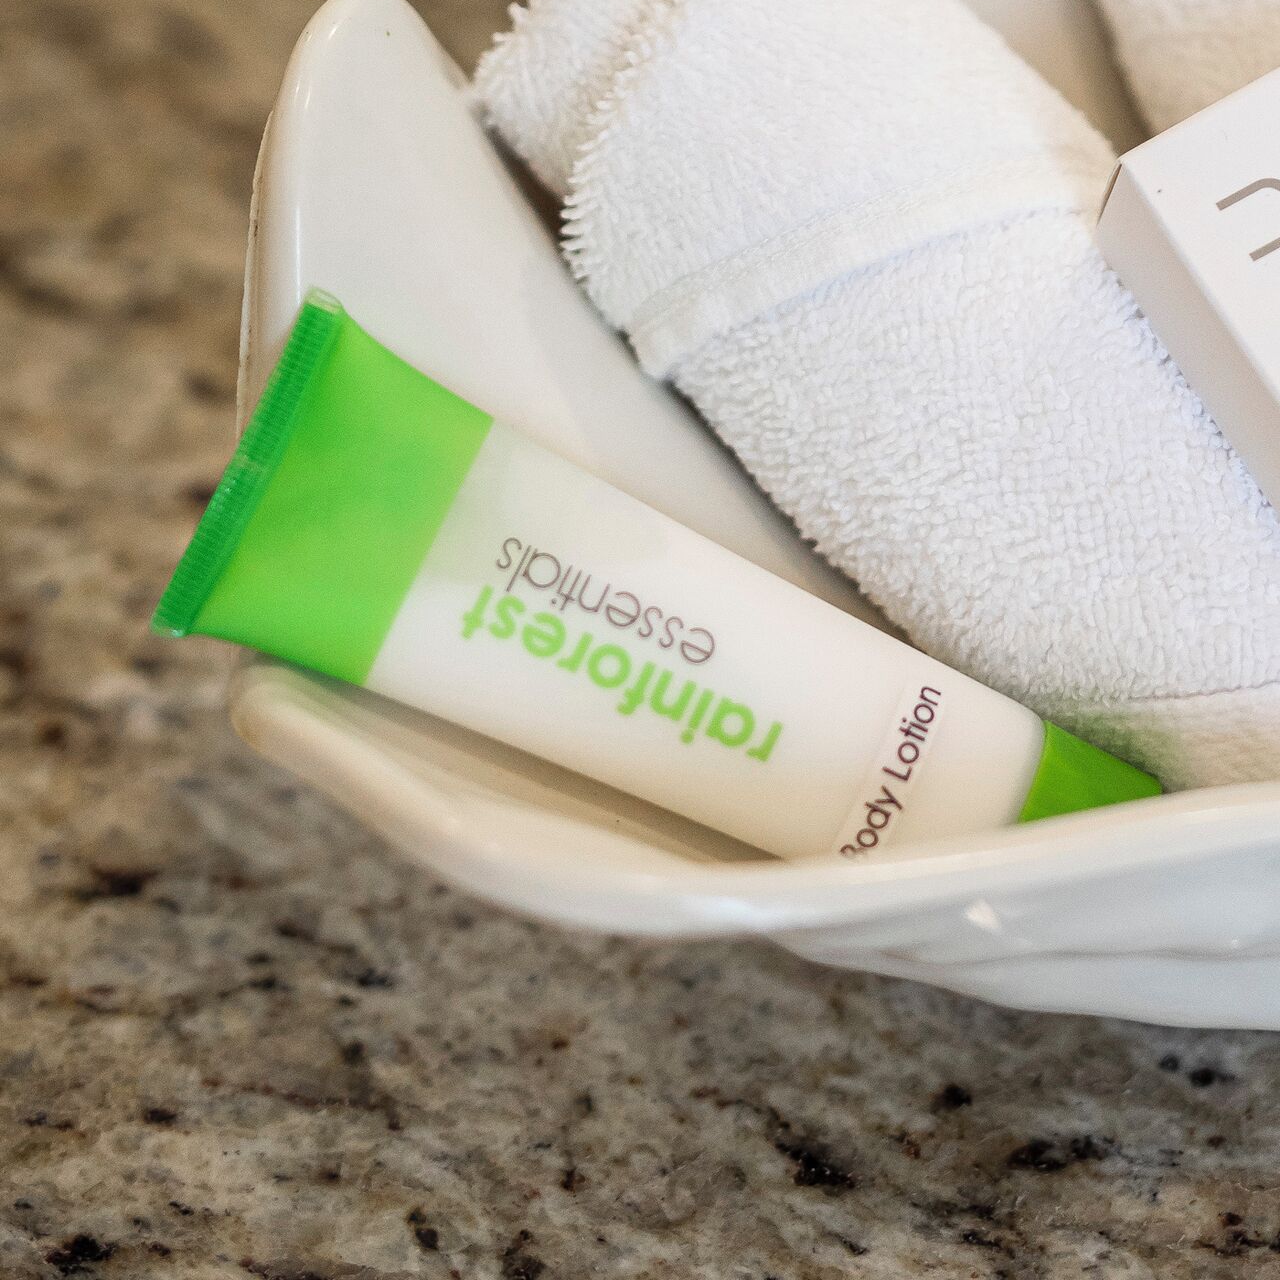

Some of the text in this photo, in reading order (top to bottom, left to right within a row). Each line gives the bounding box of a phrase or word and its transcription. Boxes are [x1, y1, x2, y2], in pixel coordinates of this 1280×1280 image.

[495, 536, 716, 664] essentials
[460, 583, 785, 763] rainforest
[882, 685, 942, 783] Lotion
